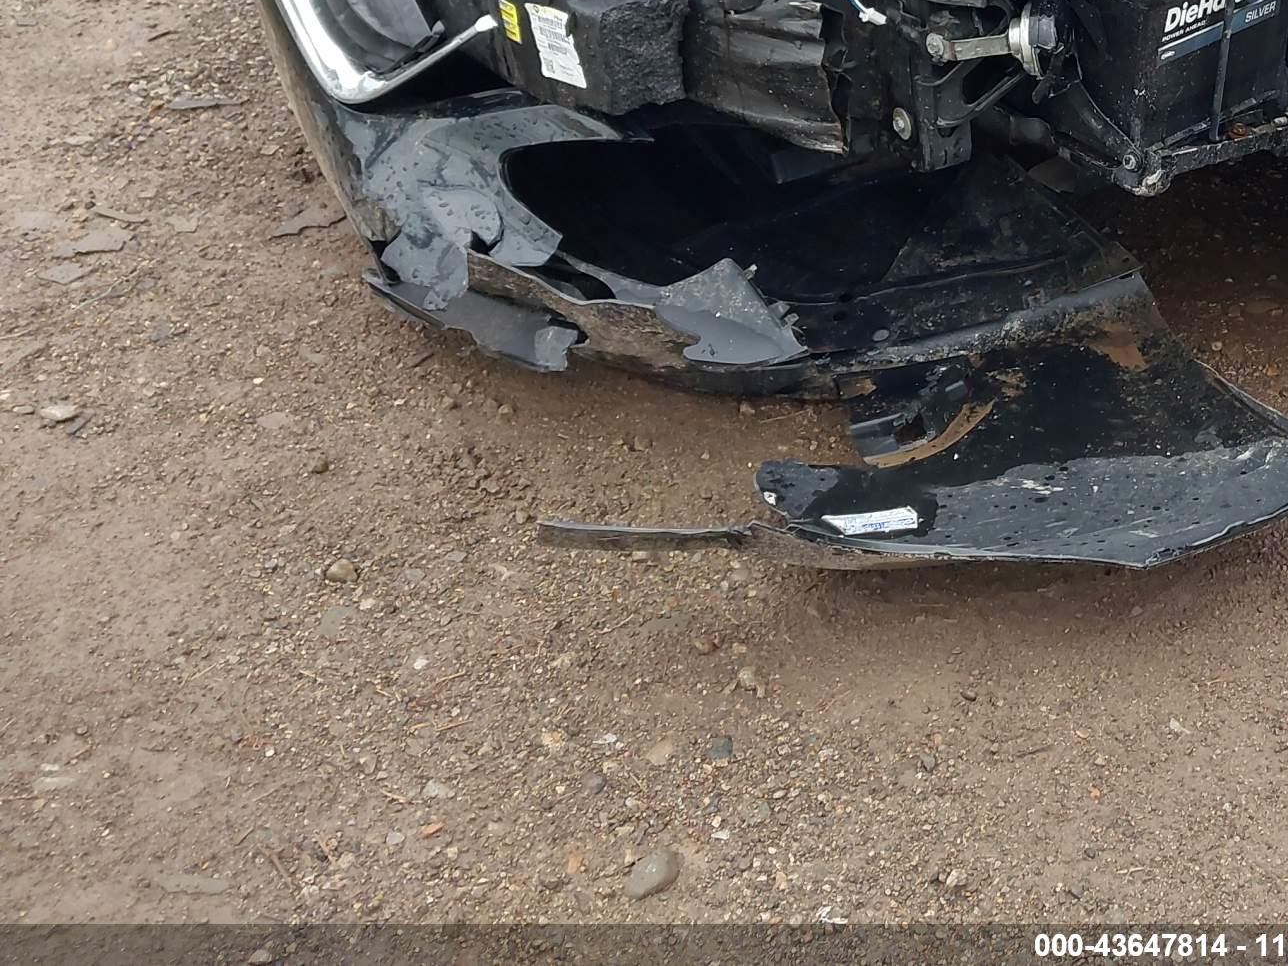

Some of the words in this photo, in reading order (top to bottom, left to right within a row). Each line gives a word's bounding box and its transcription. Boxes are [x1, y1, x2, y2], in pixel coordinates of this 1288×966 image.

[1244, 0, 1277, 23] SILVER
[1161, 28, 1185, 43] POWER
[1185, 19, 1207, 33] AHEAD
